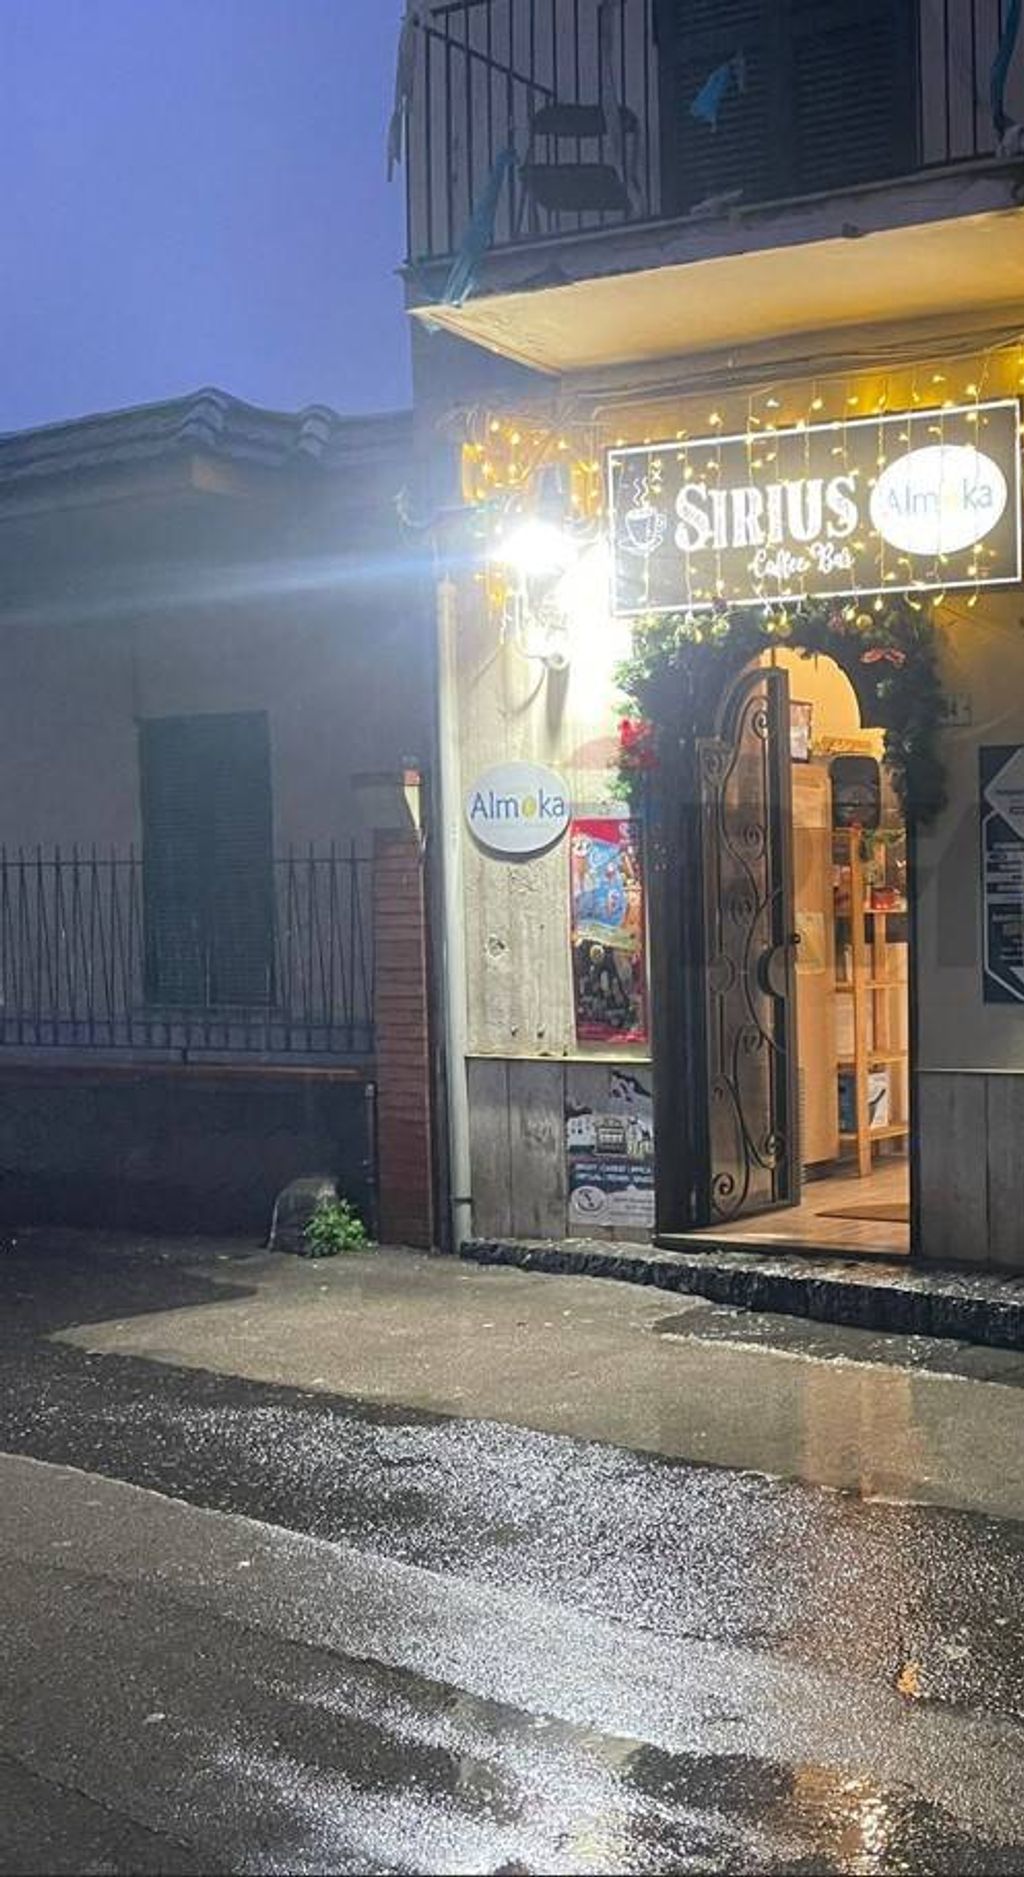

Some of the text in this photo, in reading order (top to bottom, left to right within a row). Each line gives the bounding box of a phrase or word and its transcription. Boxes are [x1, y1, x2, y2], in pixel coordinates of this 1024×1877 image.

[674, 475, 859, 552] SIRIUS
[750, 541, 855, 580] Coffee Bar
[469, 788, 565, 820] Almoka
